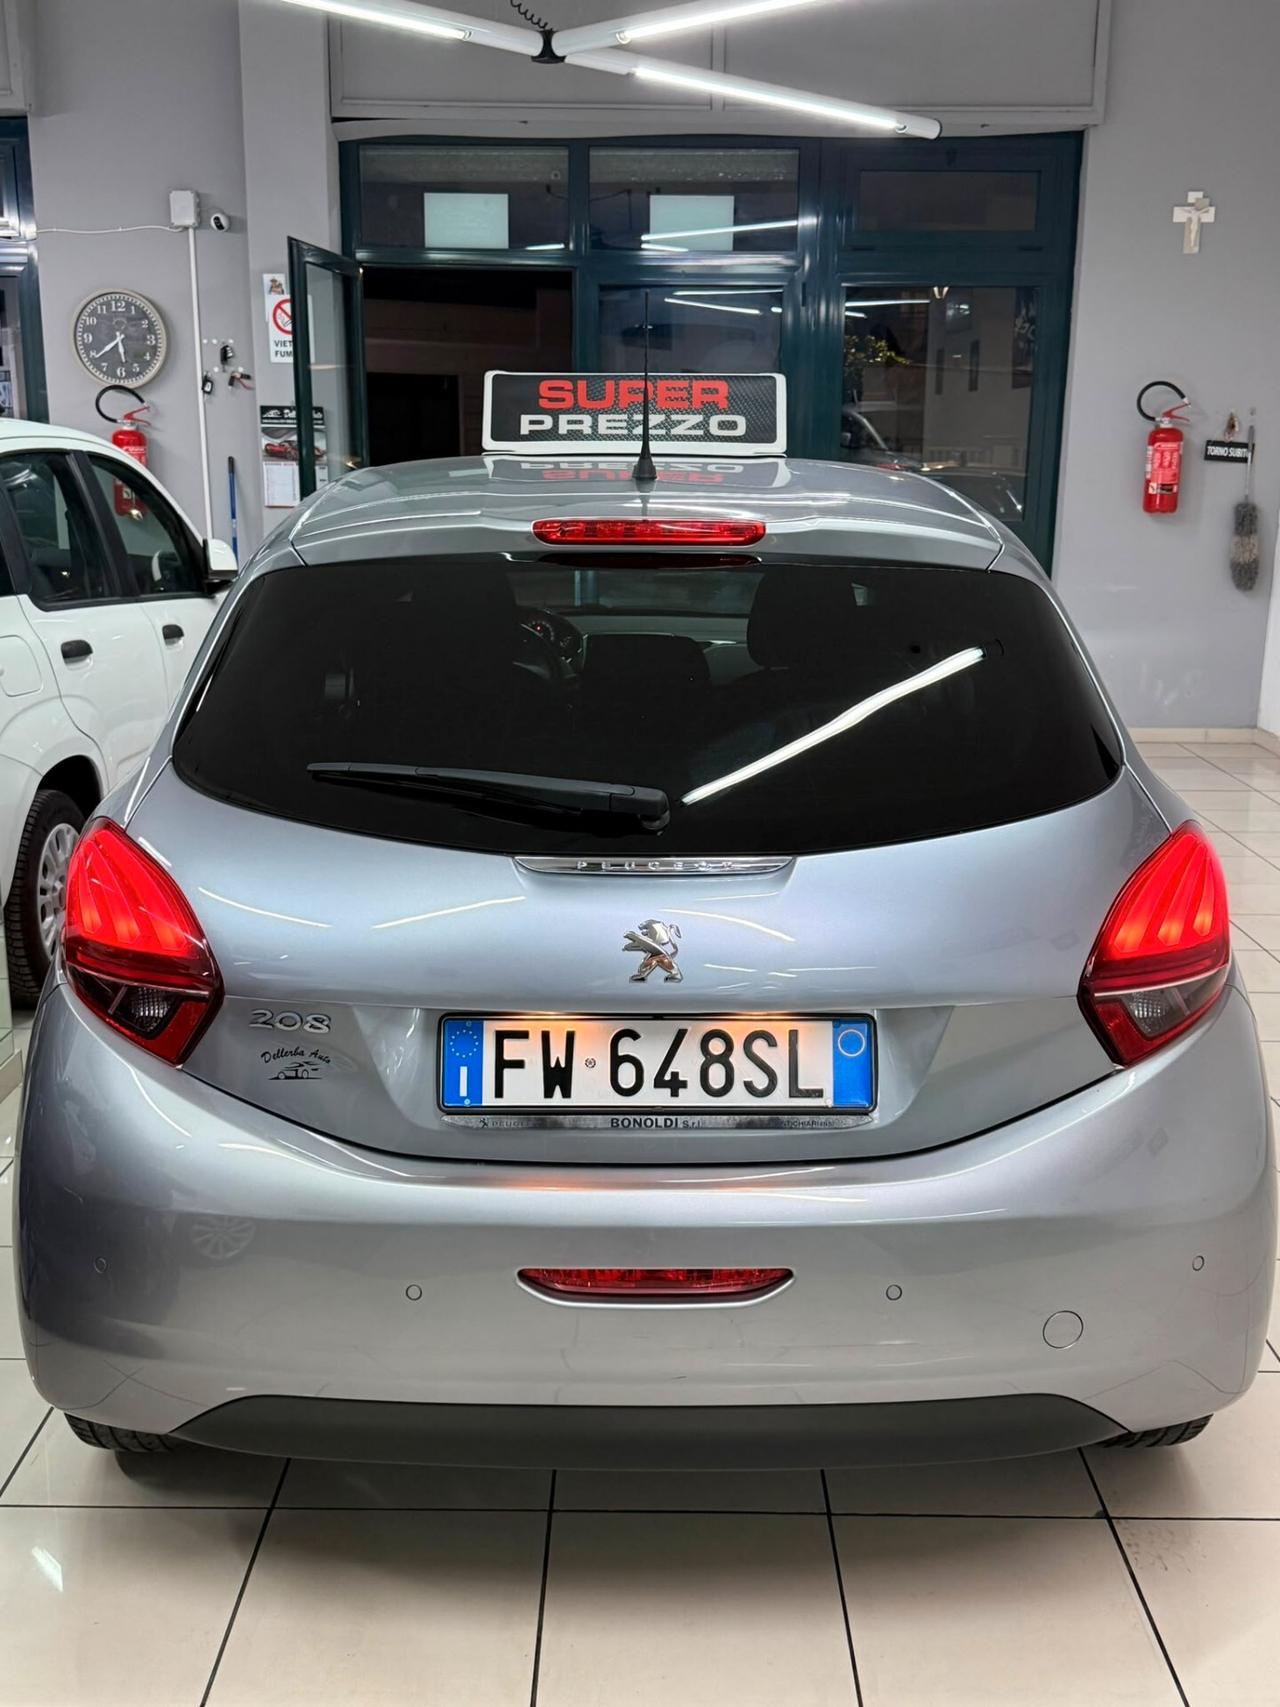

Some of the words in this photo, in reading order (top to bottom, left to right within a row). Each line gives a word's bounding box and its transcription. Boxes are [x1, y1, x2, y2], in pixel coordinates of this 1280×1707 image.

[97, 305, 107, 314] 11
[110, 300, 126, 311] 12
[130, 305, 136, 315] 1
[86, 316, 97, 325] 10
[141, 319, 149, 328] 2
[83, 332, 93, 343] 9
[146, 334, 156, 346] 3
[274, 340, 293, 348] VIET
[143, 352, 151, 361] 4
[275, 350, 293, 358] FUM
[101, 362, 108, 372] 7
[116, 366, 126, 378] 6
[132, 363, 140, 372] 5
[538, 379, 730, 410] SUPER
[520, 413, 747, 437] PREZZO
[1207, 445, 1228, 457] TORNO
[248, 1008, 331, 1034] 208
[260, 1046, 305, 1064] Dellerba
[308, 1049, 331, 1064] Auto
[494, 1029, 576, 1099] FW
[609, 1027, 824, 1099] 648SL
[610, 1117, 679, 1129] BONOLDI
